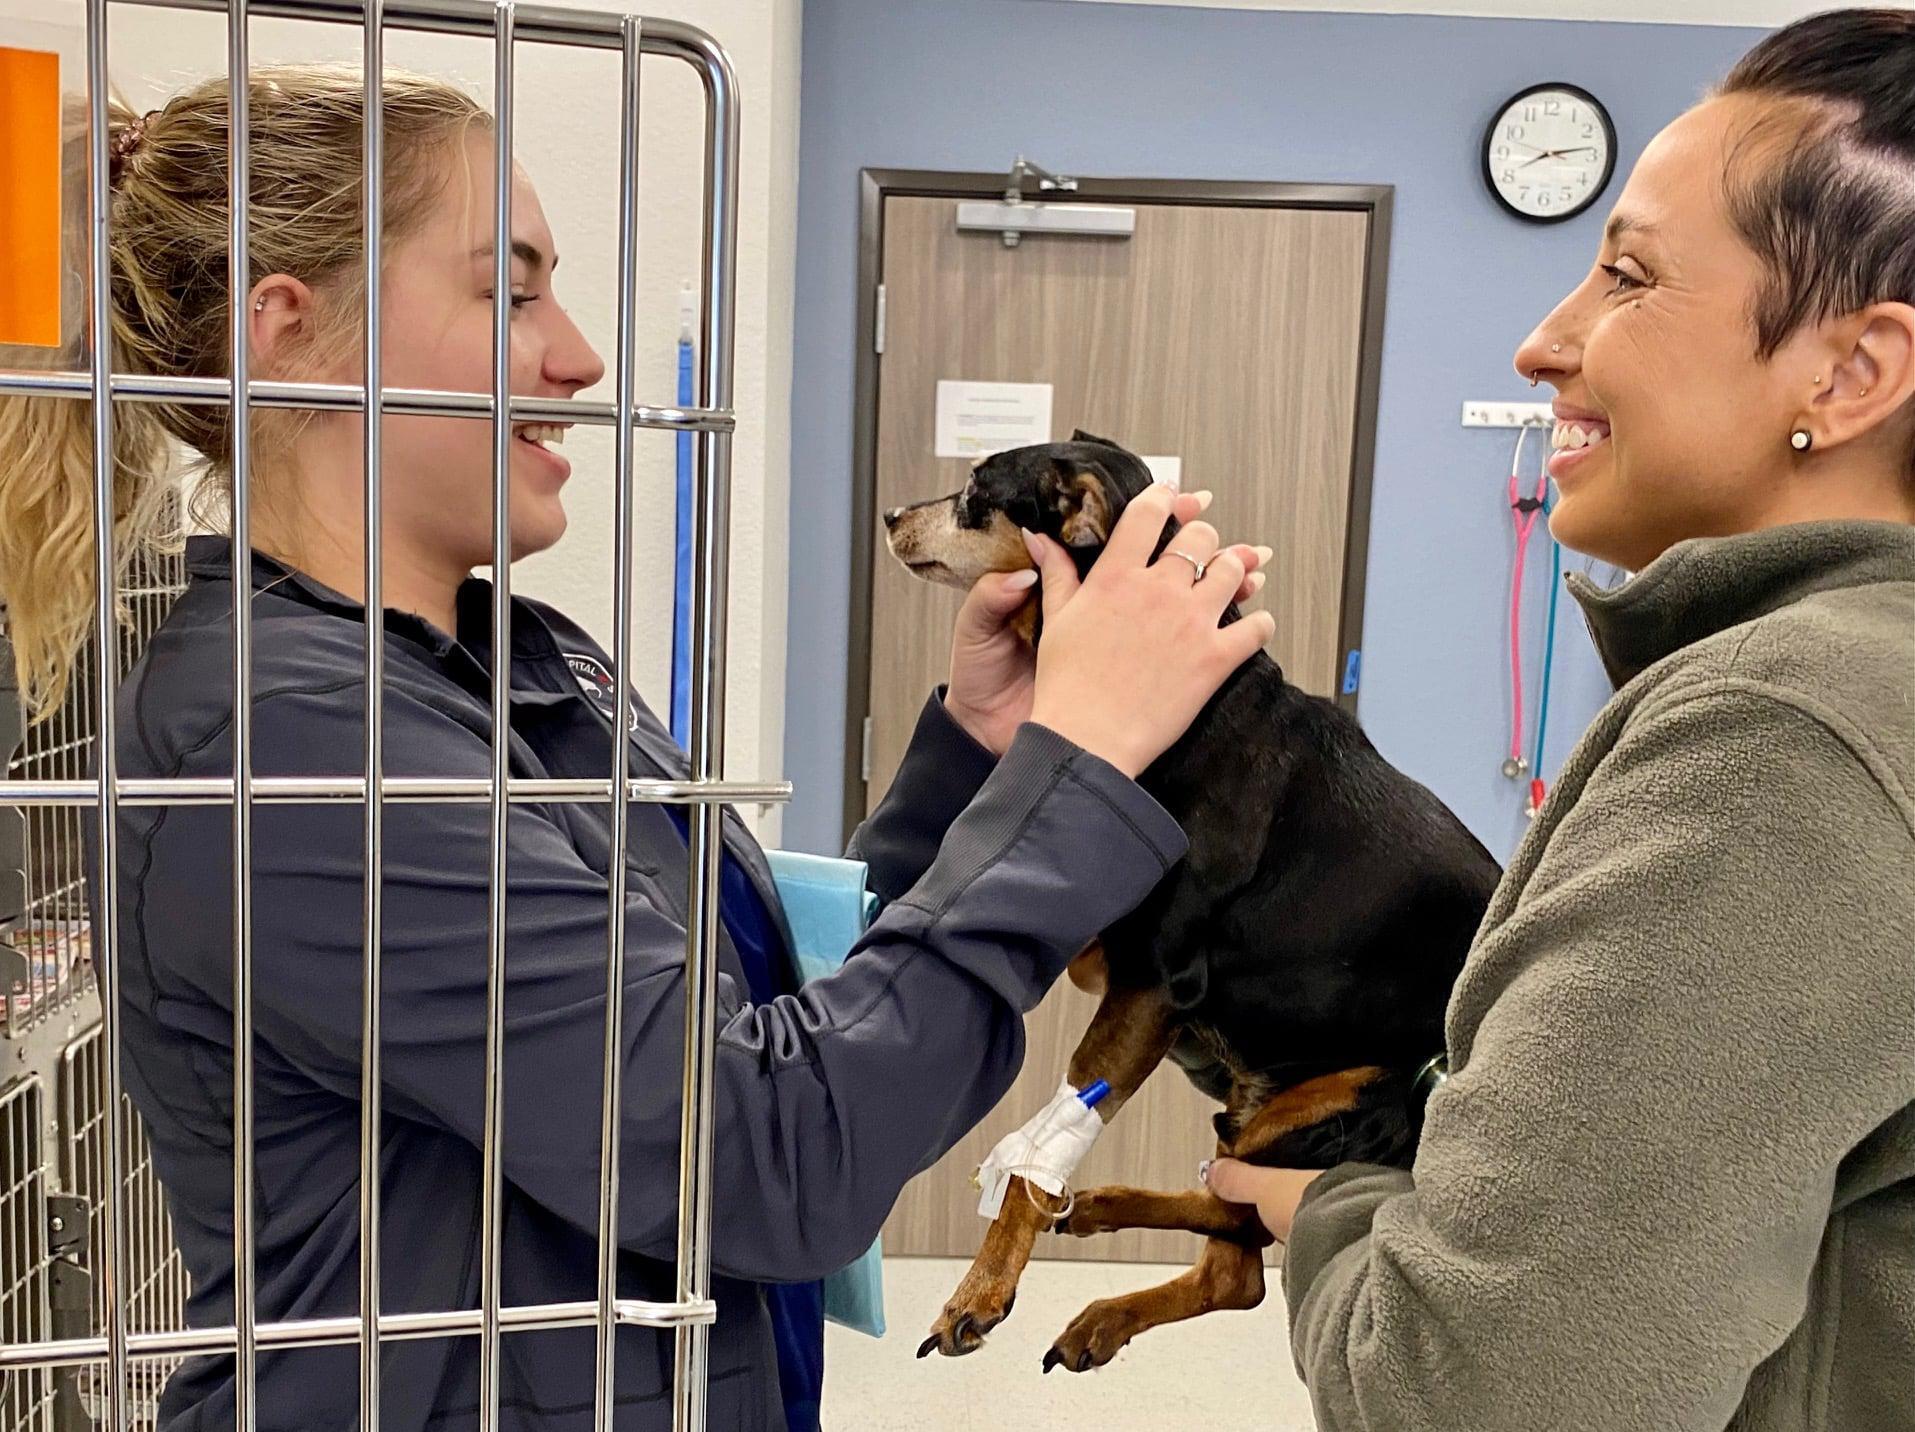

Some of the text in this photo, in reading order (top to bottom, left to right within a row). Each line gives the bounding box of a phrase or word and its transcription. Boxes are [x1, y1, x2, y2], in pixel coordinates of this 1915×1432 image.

[1524, 107, 1536, 122] 11
[1544, 101, 1560, 116] 12
[1572, 108, 1577, 123] 1
[1506, 125, 1525, 141] 10
[1581, 124, 1593, 138] 2
[1497, 147, 1510, 160] 9
[1585, 148, 1597, 162] 3
[1502, 169, 1515, 183] 8
[1576, 172, 1588, 186] 4
[1518, 185, 1530, 200] 7
[1537, 192, 1550, 207] 6
[1558, 186, 1572, 201] 5
